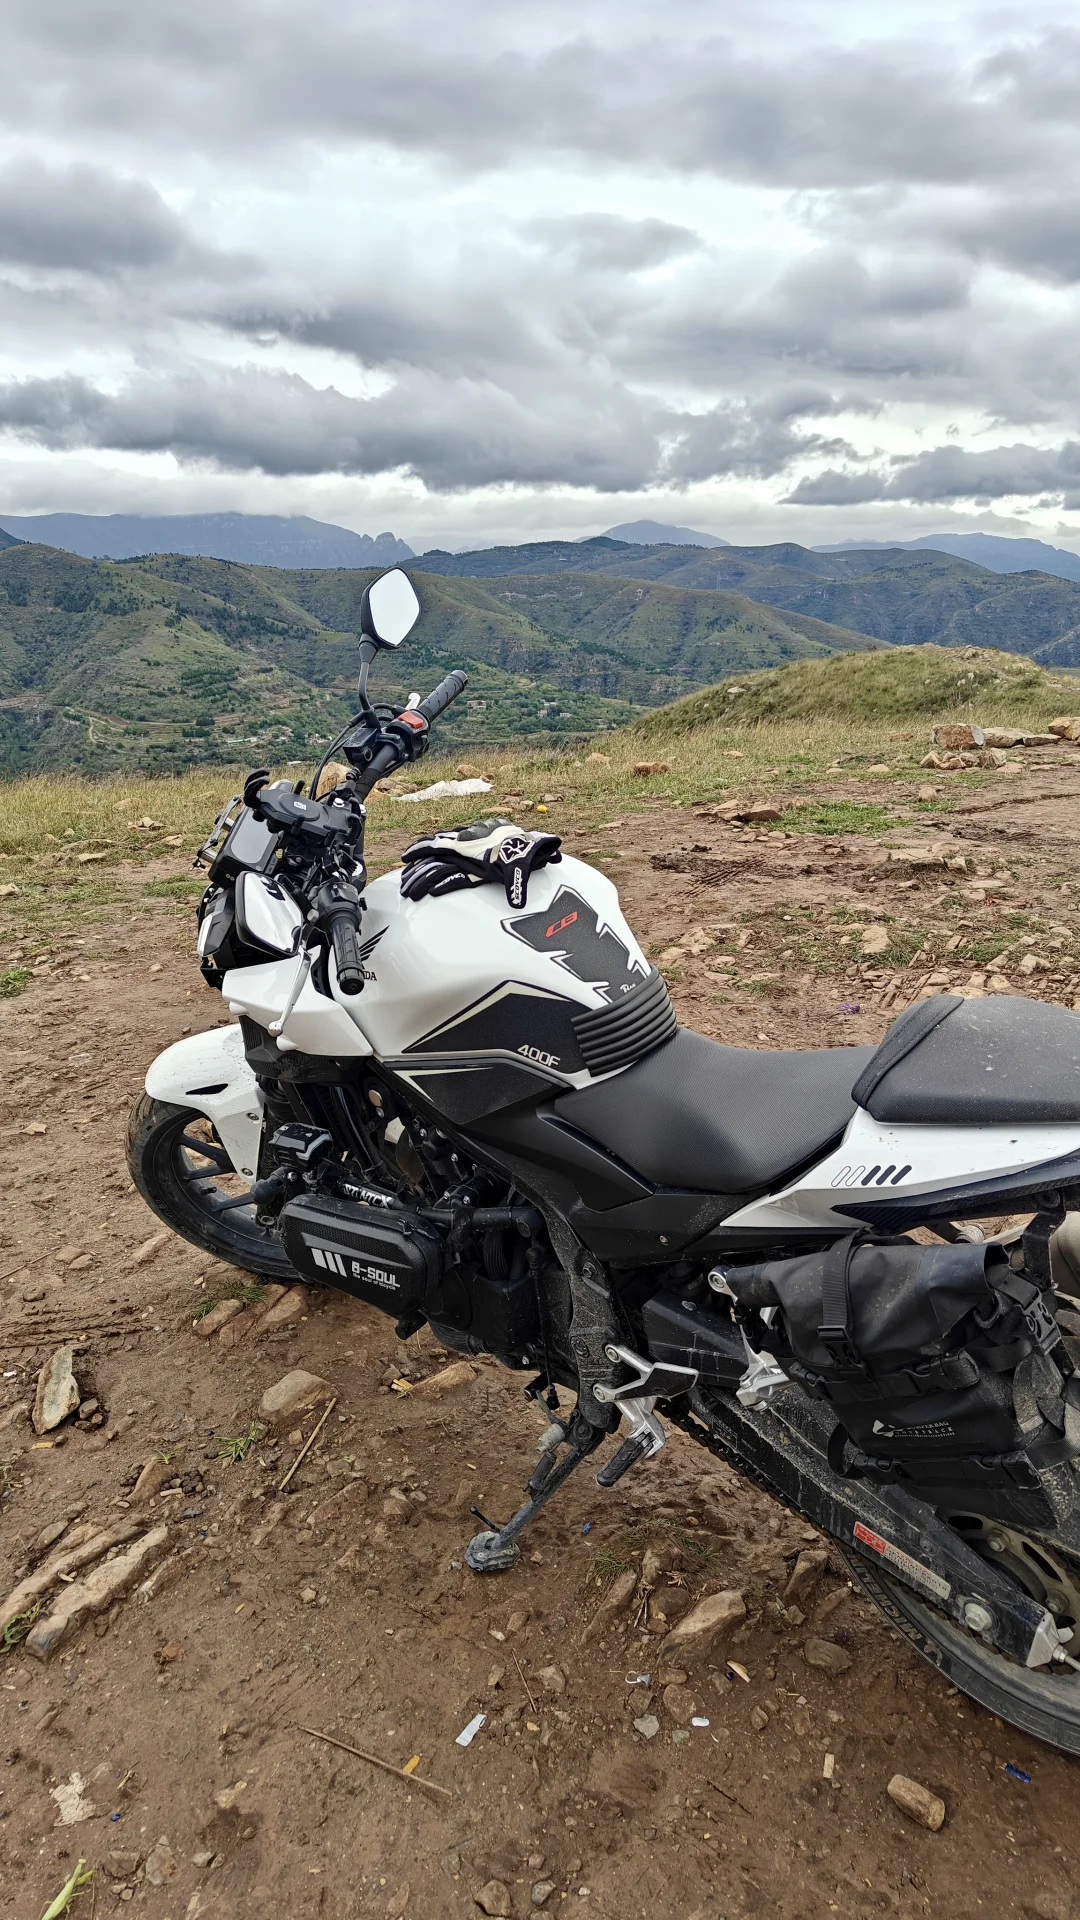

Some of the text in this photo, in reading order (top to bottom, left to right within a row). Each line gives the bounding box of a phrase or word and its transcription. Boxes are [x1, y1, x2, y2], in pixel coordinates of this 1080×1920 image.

[545, 912, 578, 937] CB
[517, 1045, 560, 1067] 400F
[352, 1261, 400, 1287] B-SOUL
[379, 1282, 396, 1290] bicycle
